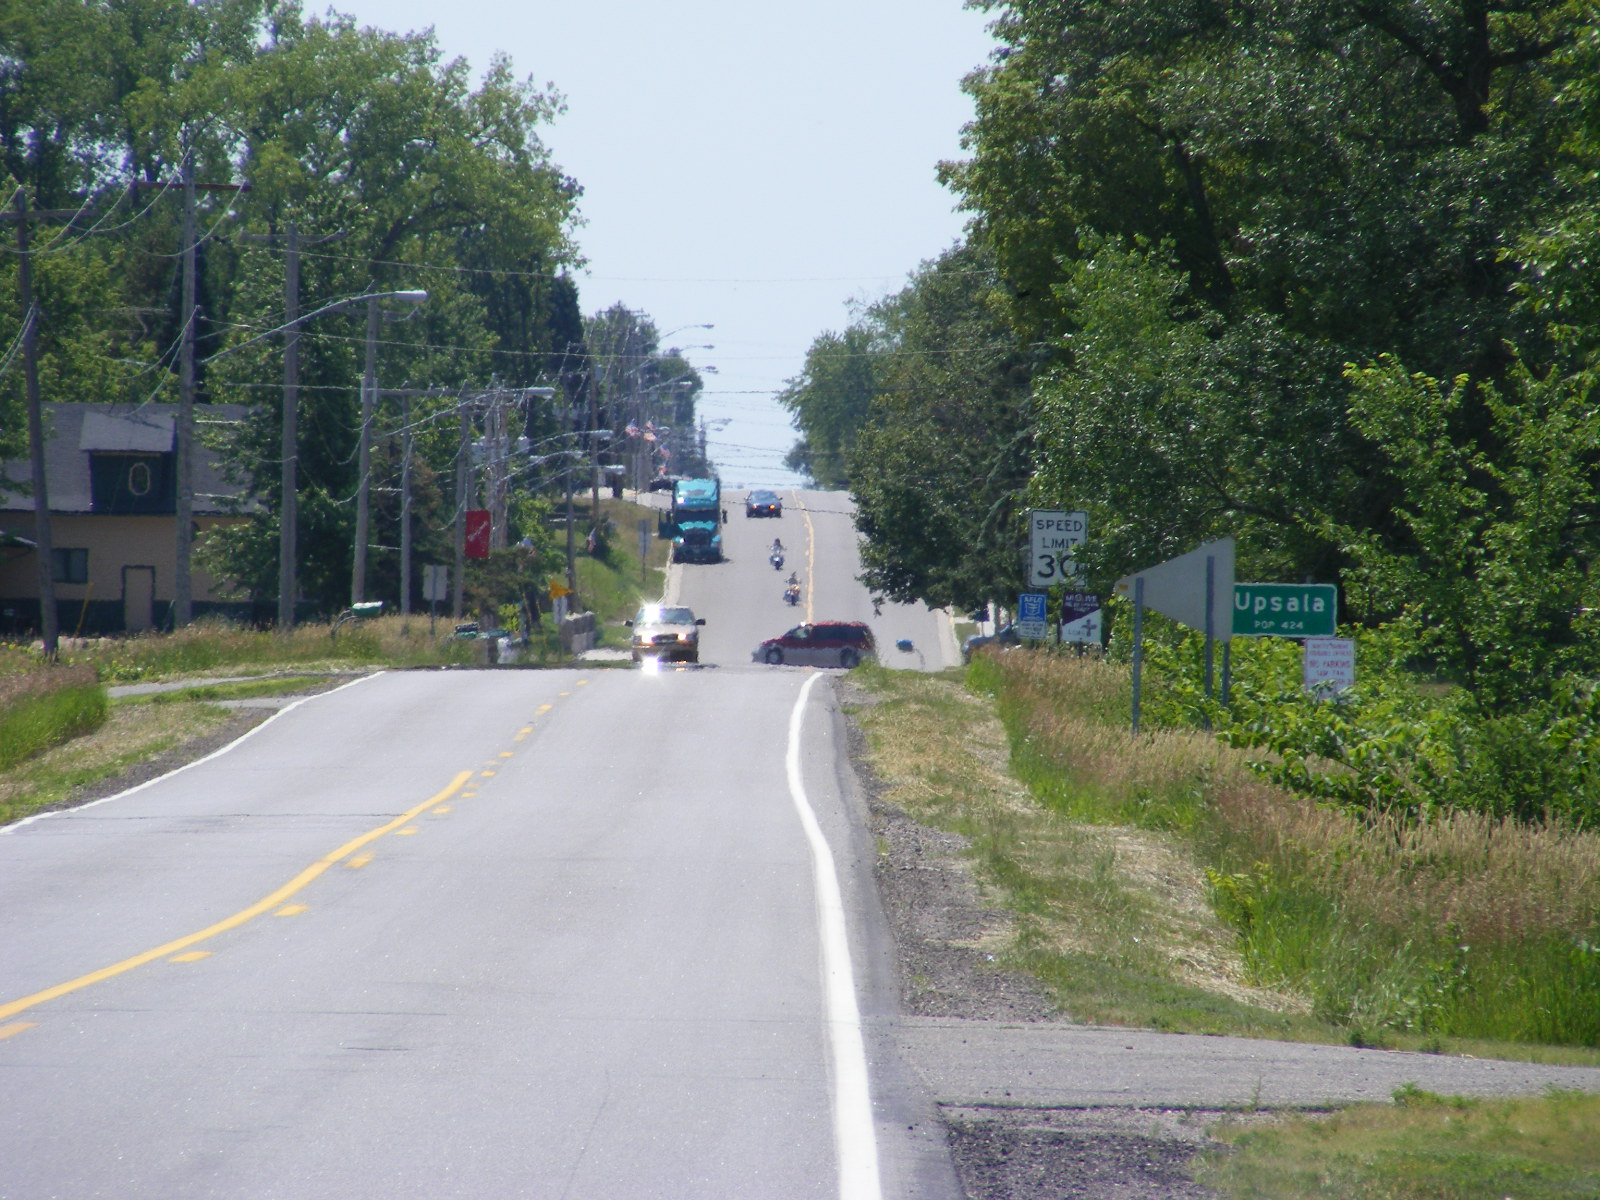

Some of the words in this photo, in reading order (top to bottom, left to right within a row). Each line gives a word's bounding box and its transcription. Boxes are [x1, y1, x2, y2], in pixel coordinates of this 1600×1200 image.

[1036, 519, 1083, 532] SPEED
[1042, 537, 1078, 549] LIMIT
[1235, 591, 1325, 615] Upsala
[1254, 620, 1275, 629] POP
[1281, 621, 1304, 630] 424
